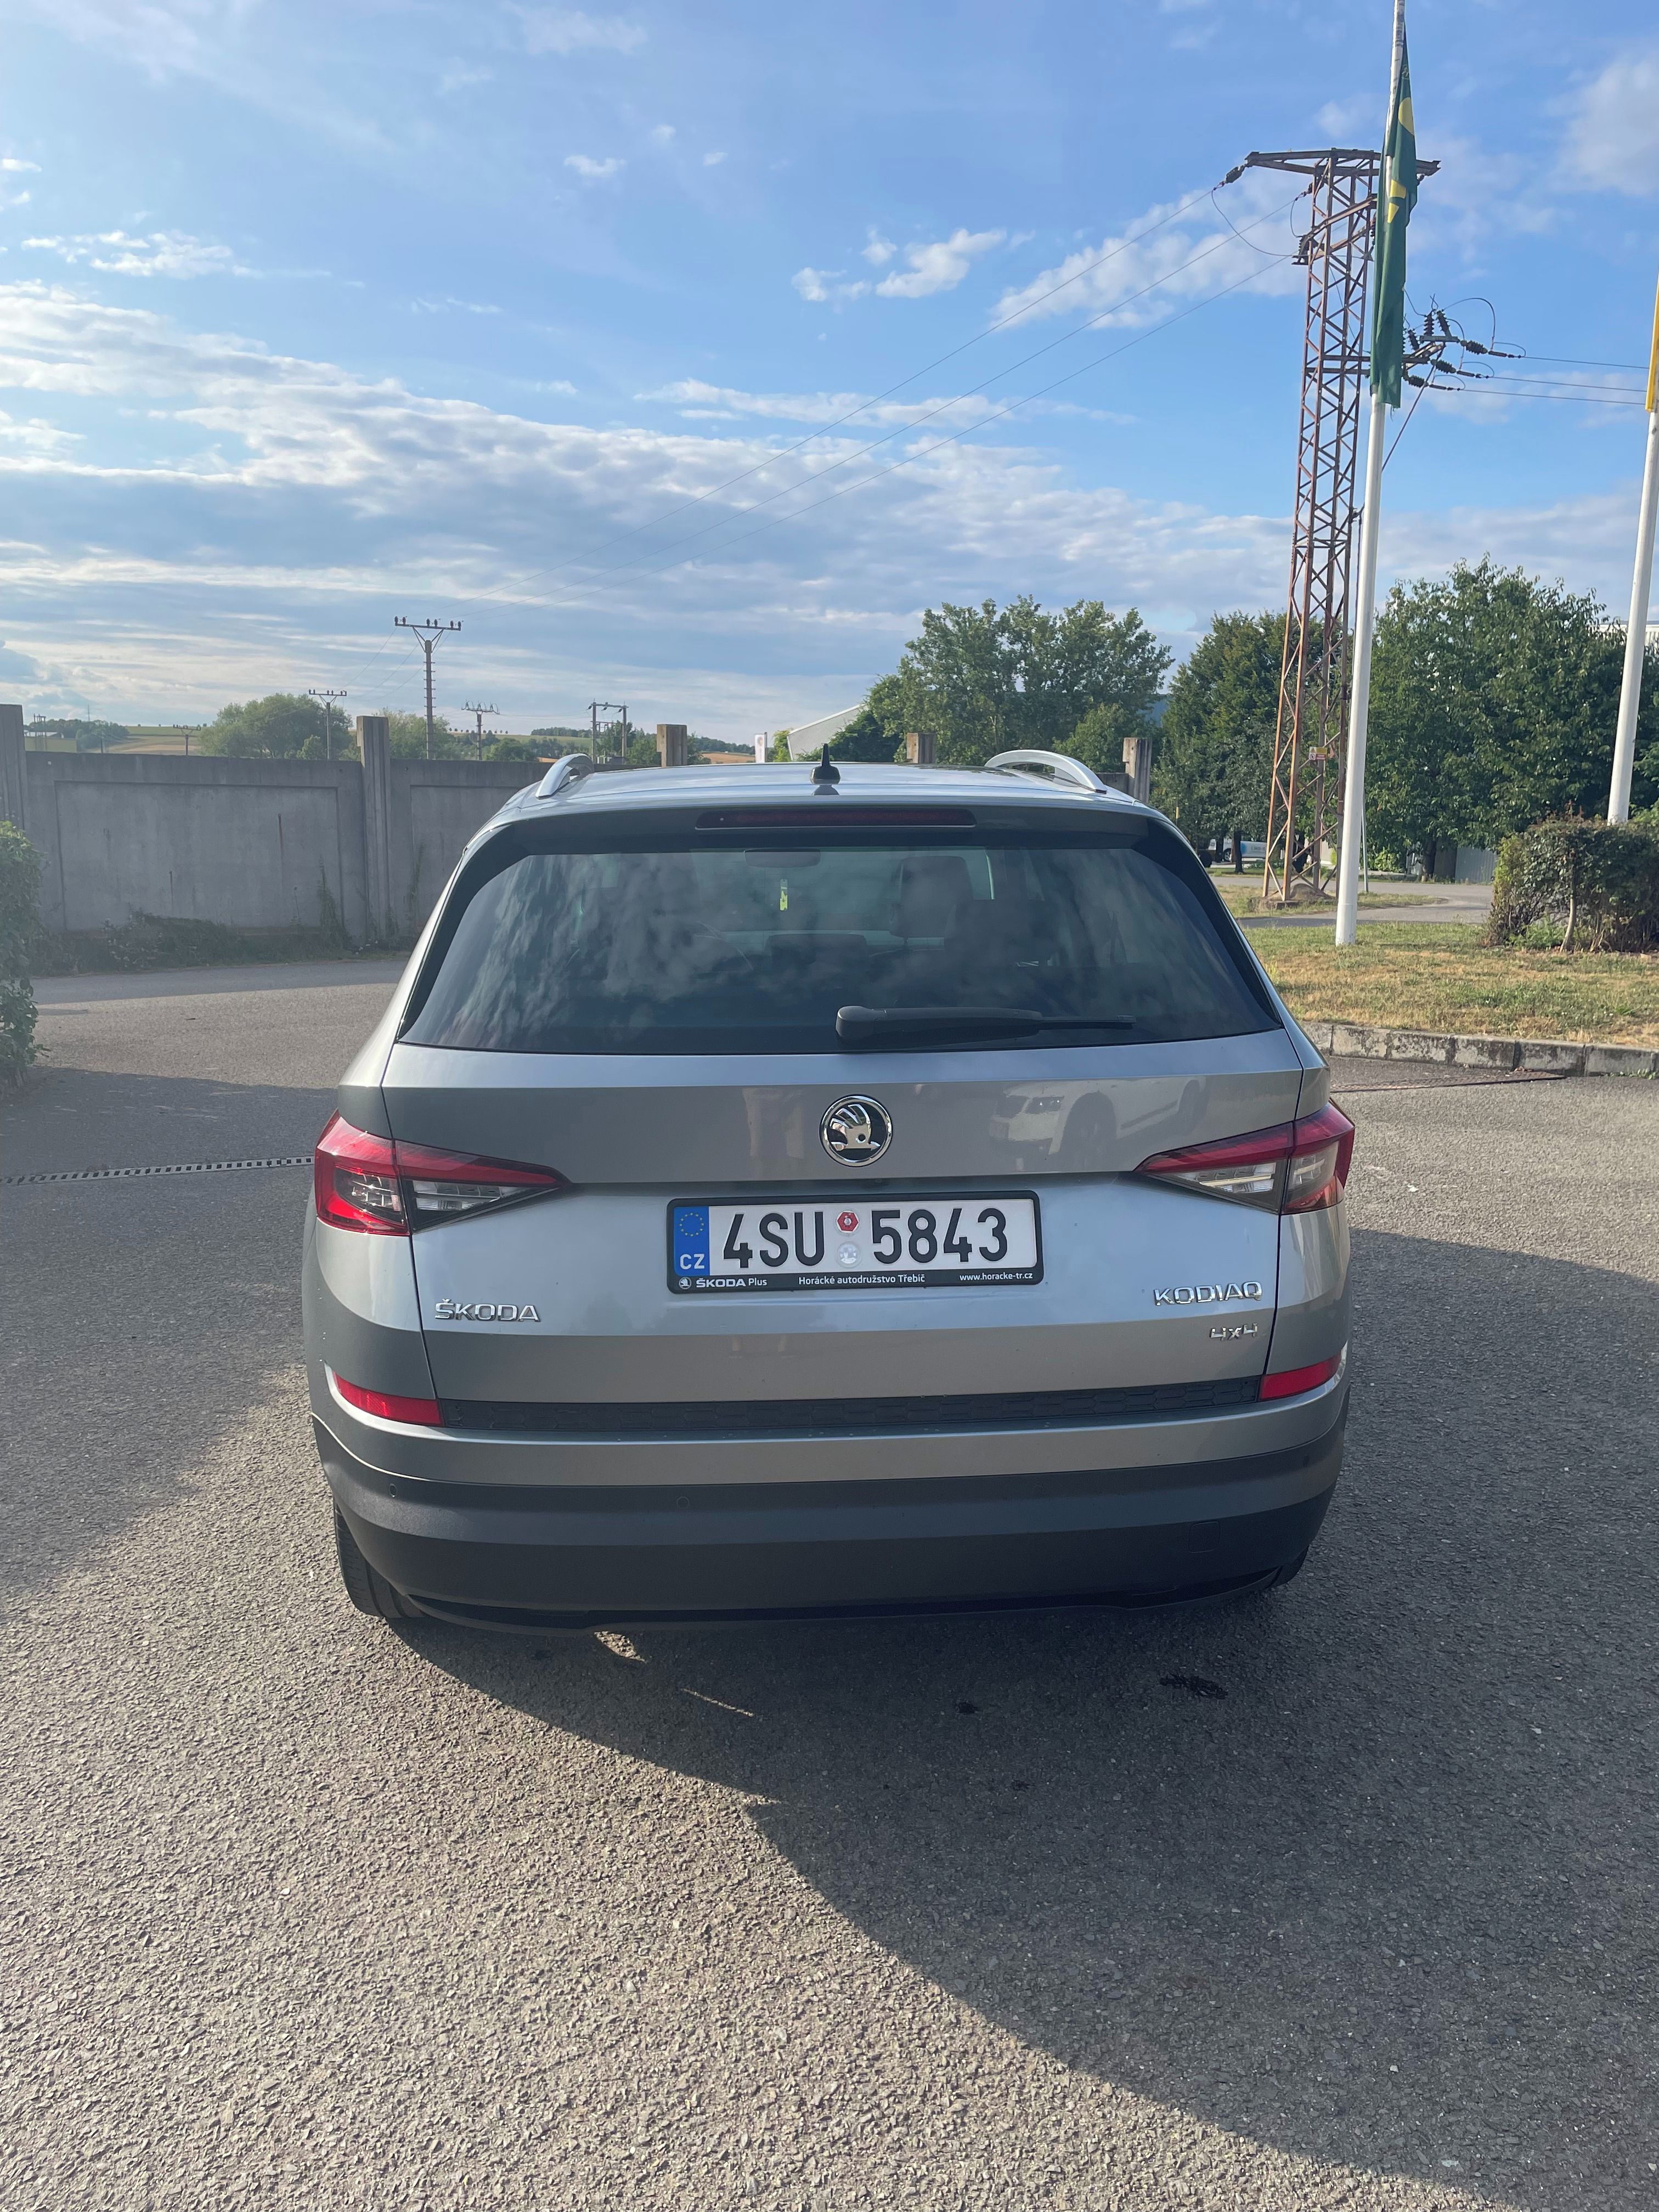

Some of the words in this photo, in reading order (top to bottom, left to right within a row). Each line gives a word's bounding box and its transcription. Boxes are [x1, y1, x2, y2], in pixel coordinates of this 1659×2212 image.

[723, 1211, 825, 1268] 4SU
[871, 1207, 1008, 1264] 5843
[680, 1253, 706, 1270] CZ
[696, 1278, 747, 1288] ŠKODA
[748, 1278, 768, 1286] Plus
[799, 1276, 835, 1285] Horácké
[837, 1274, 896, 1284] autodružstvo
[898, 1273, 926, 1283] Třebíč
[959, 1272, 1033, 1281] www.horacke-tr.cz
[1153, 1280, 1262, 1306] KODIAQ
[435, 1298, 541, 1323] ŠKODA
[1209, 1322, 1259, 1342] 4x4
